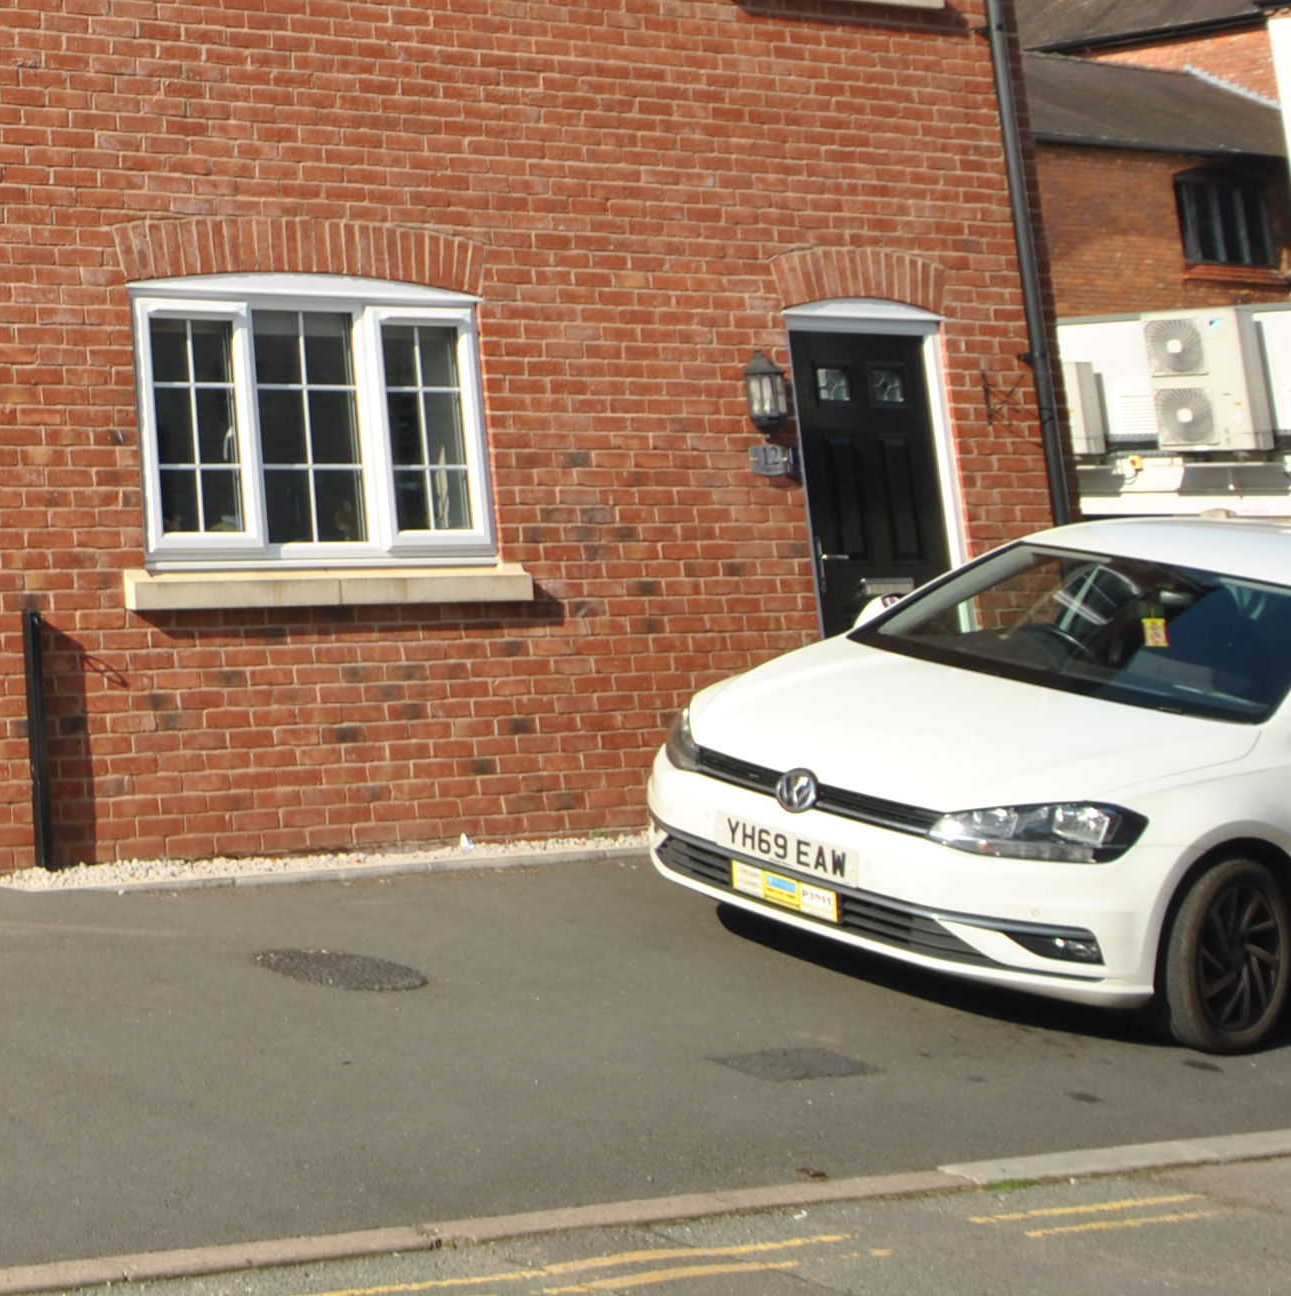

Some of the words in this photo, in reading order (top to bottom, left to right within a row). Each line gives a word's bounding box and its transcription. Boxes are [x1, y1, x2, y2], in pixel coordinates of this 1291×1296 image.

[762, 446, 780, 466] 12
[727, 817, 788, 860] YH69
[796, 839, 847, 879] EAW
